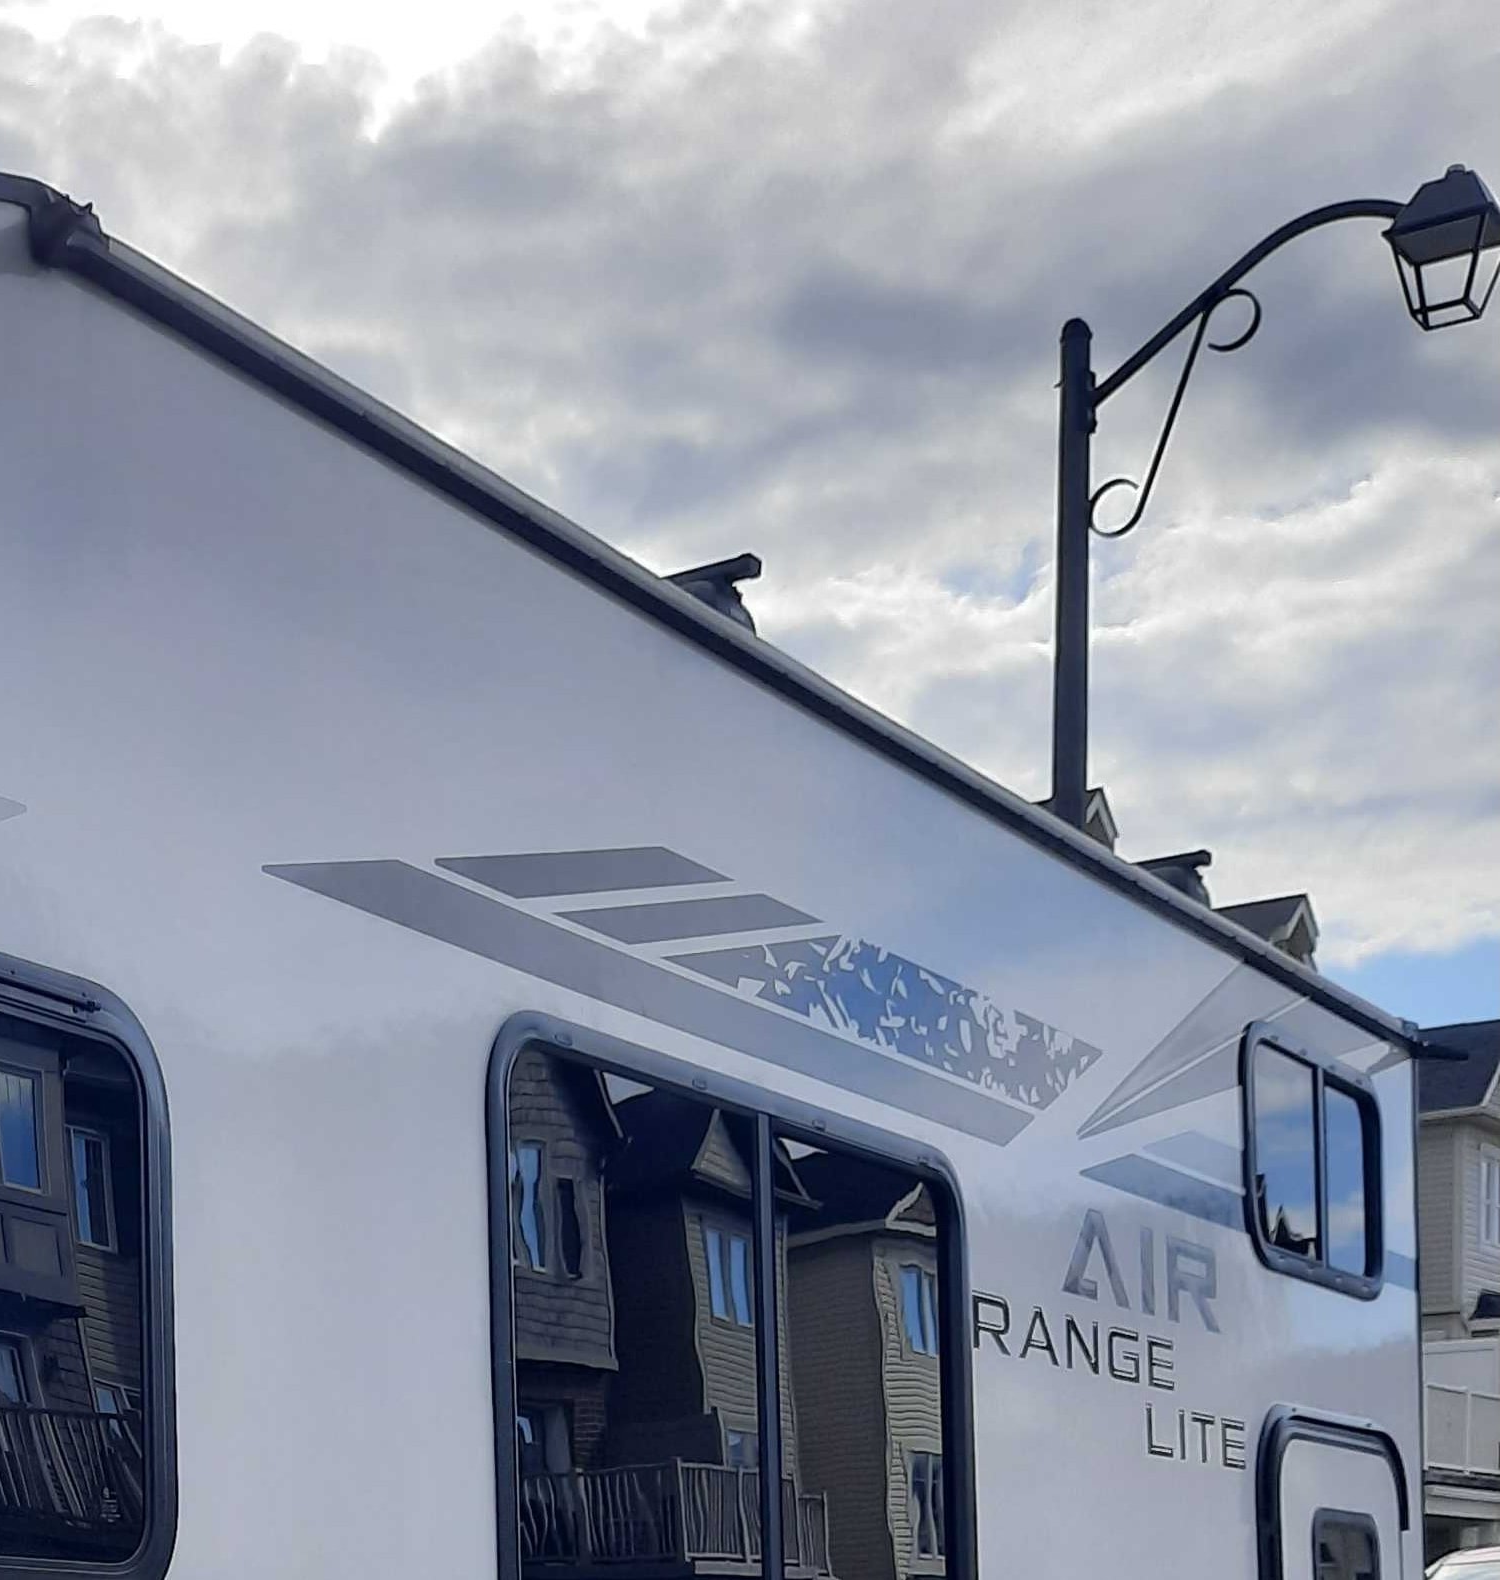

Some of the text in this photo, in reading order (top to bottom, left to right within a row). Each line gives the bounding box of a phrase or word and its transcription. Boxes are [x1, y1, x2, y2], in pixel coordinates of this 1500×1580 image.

[1061, 1207, 1221, 1334] AIR
[971, 1289, 1175, 1391] RANGE
[1145, 1402, 1247, 1470] LITE
